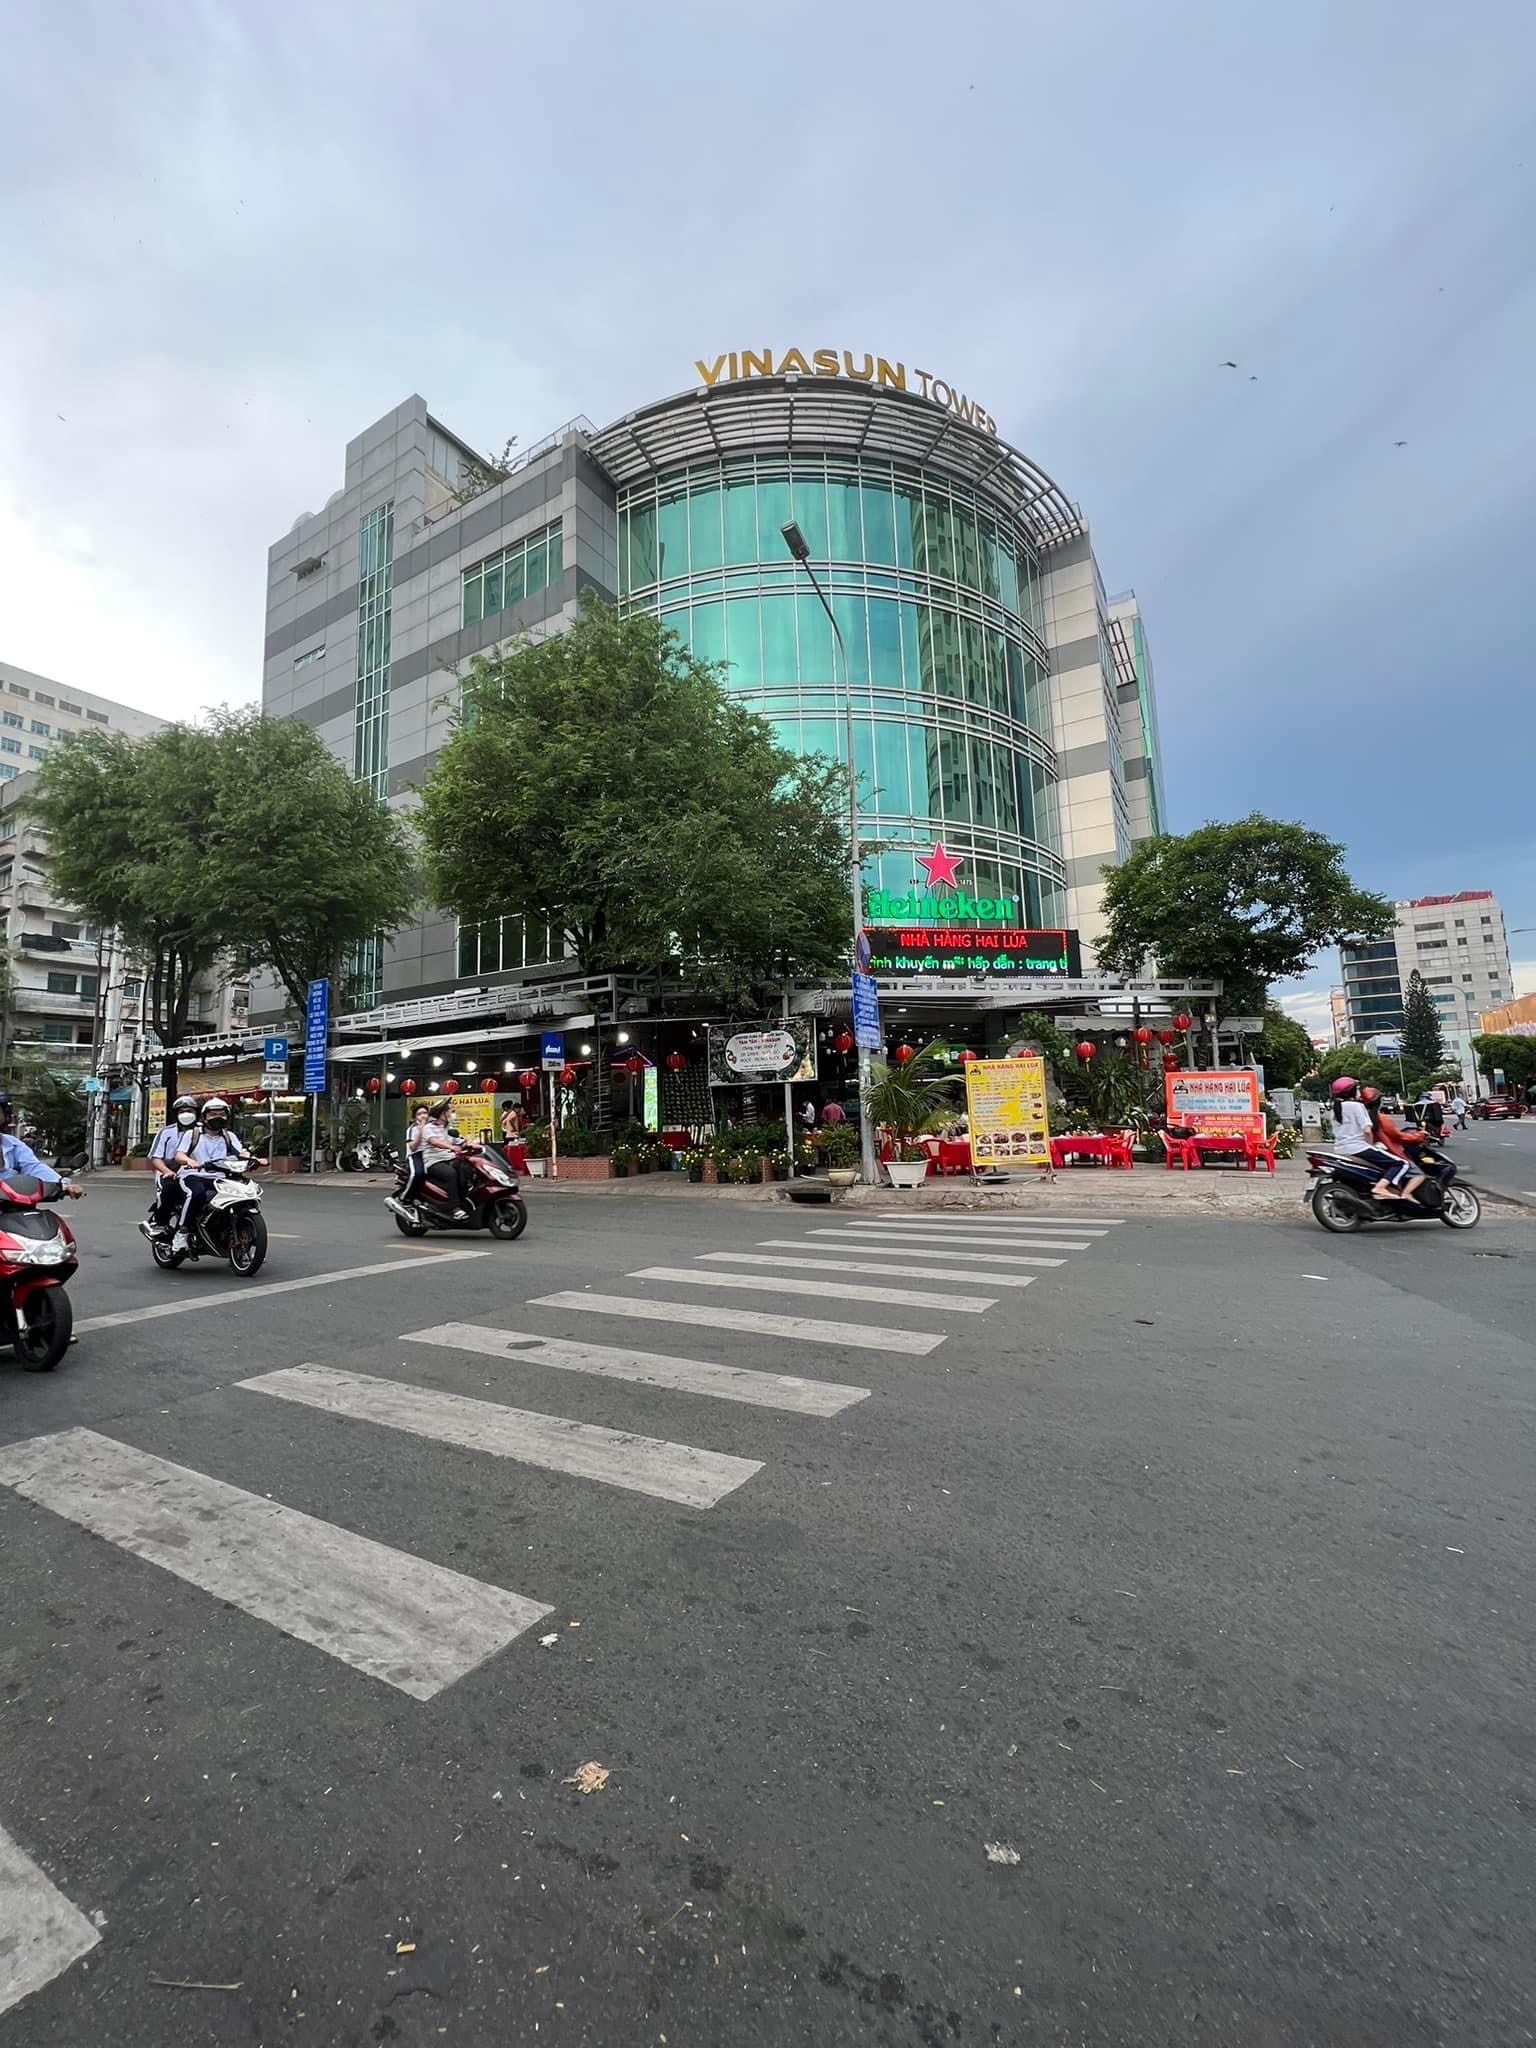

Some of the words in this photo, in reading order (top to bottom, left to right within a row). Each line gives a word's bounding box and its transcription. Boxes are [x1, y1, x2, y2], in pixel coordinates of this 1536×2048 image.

[694, 348, 907, 391] VINASUN
[914, 369, 999, 436] TOWER
[901, 932, 930, 948] NHÀ
[934, 932, 972, 948] HÀNG
[976, 935, 999, 948] HAI
[272, 1042, 284, 1055] P
